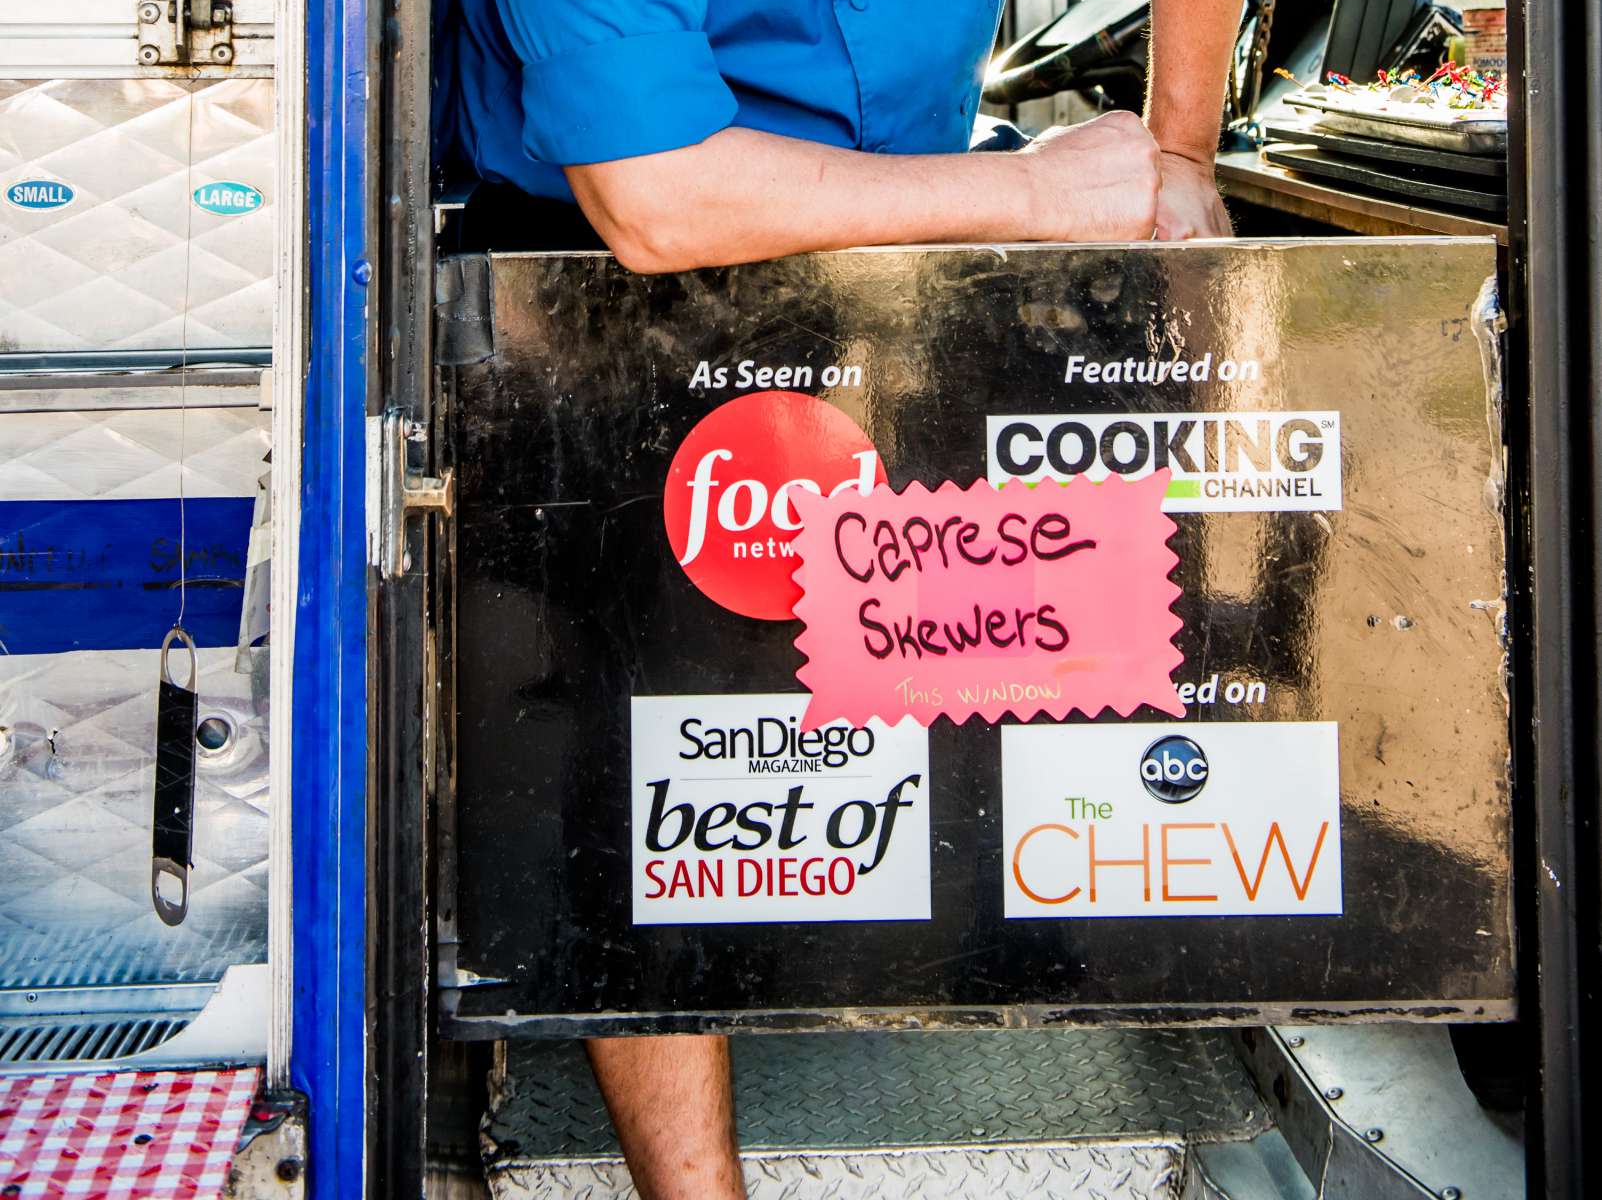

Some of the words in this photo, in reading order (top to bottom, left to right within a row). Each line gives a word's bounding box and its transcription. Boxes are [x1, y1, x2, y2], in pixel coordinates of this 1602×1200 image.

[13, 186, 68, 203] SMALL
[201, 188, 257, 208] LARGE
[688, 360, 729, 389] As
[735, 360, 812, 388] Seen
[820, 364, 862, 387] on
[1064, 353, 1211, 384] Featured
[1217, 359, 1259, 382] on
[995, 418, 1324, 476] COOKING
[1203, 478, 1323, 498] CHANNEL
[732, 537, 796, 559] netw
[834, 511, 1097, 583] Caprese
[858, 598, 1070, 660] Skewers
[894, 675, 943, 706] This
[1174, 674, 1219, 704] ed
[1224, 680, 1267, 704] on
[748, 758, 823, 774] MAGAZINE
[1140, 750, 1209, 782] abc
[1064, 797, 1113, 820] The
[644, 777, 815, 852] best
[825, 773, 922, 876] of
[644, 857, 724, 899] SAN
[736, 856, 856, 898] DIEGO
[1012, 820, 1329, 905] CHEW
